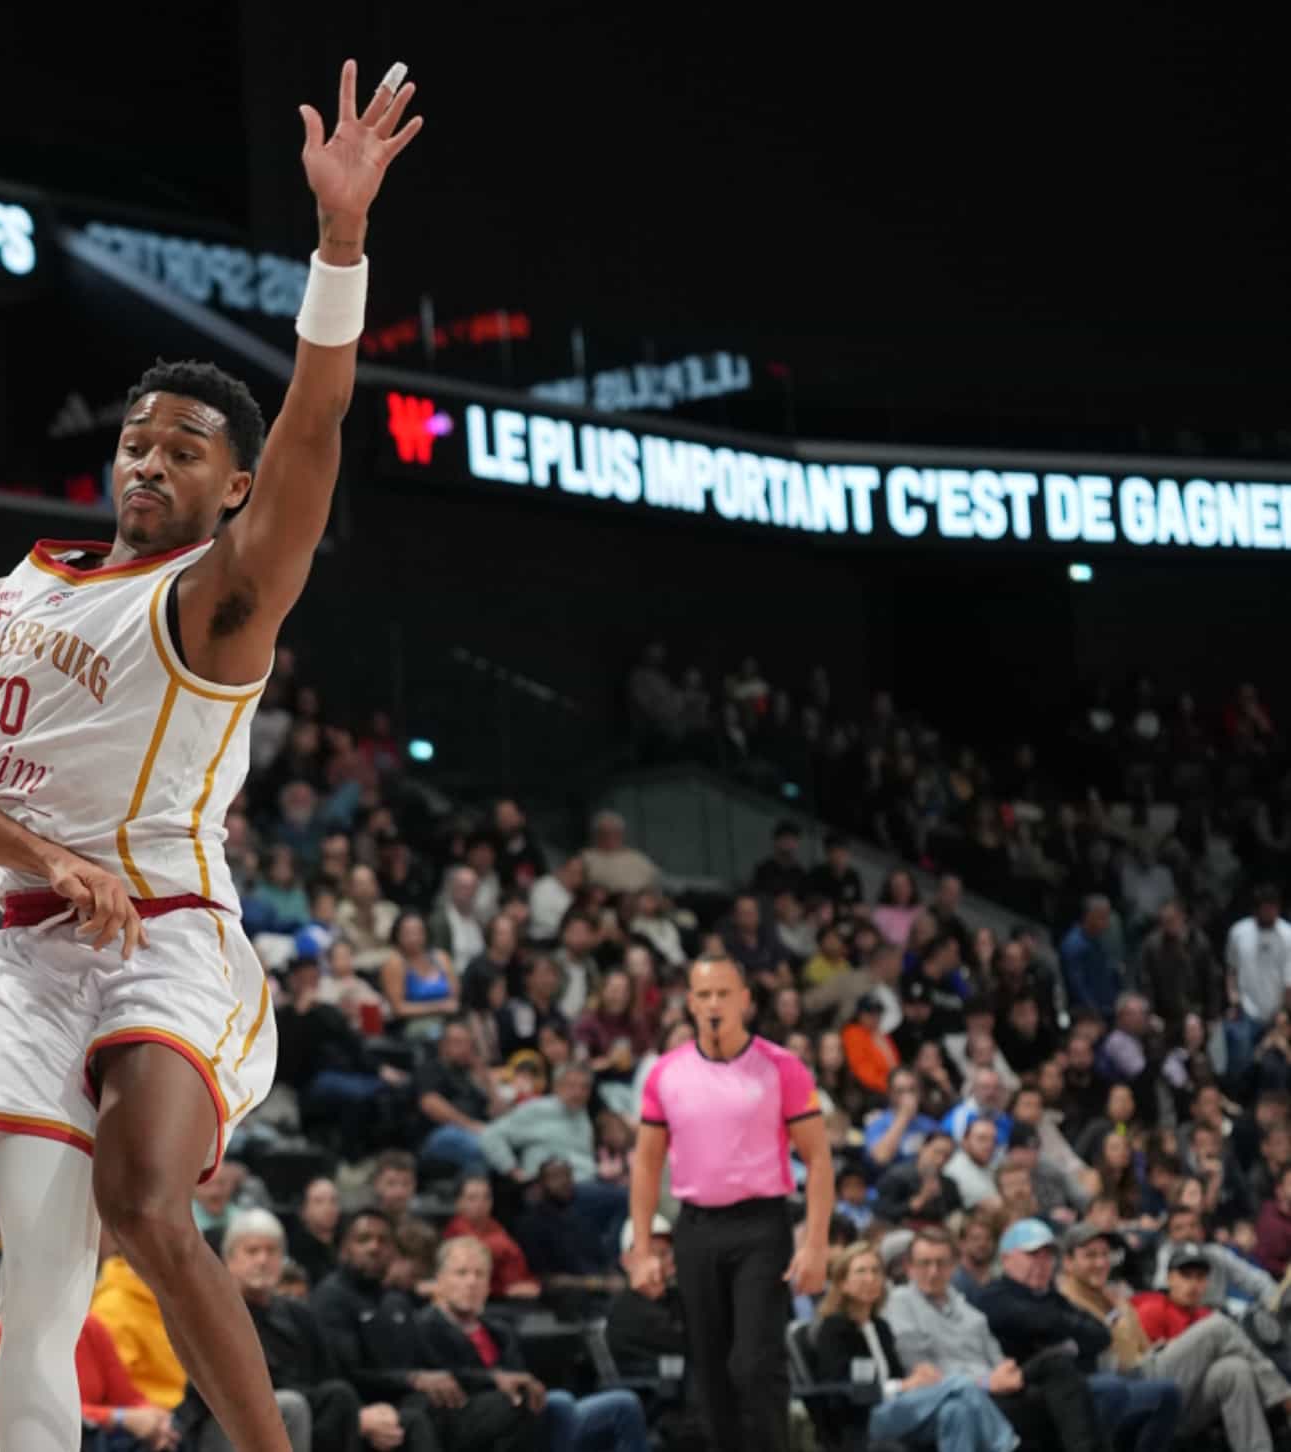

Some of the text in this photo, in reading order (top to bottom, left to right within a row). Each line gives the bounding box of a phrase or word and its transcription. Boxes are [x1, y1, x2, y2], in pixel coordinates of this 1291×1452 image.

[466, 403, 530, 484] LE
[529, 416, 643, 504] PLUS
[641, 434, 881, 534] IMPORTANT
[885, 466, 1039, 540] C'EST
[1043, 473, 1118, 543] DE
